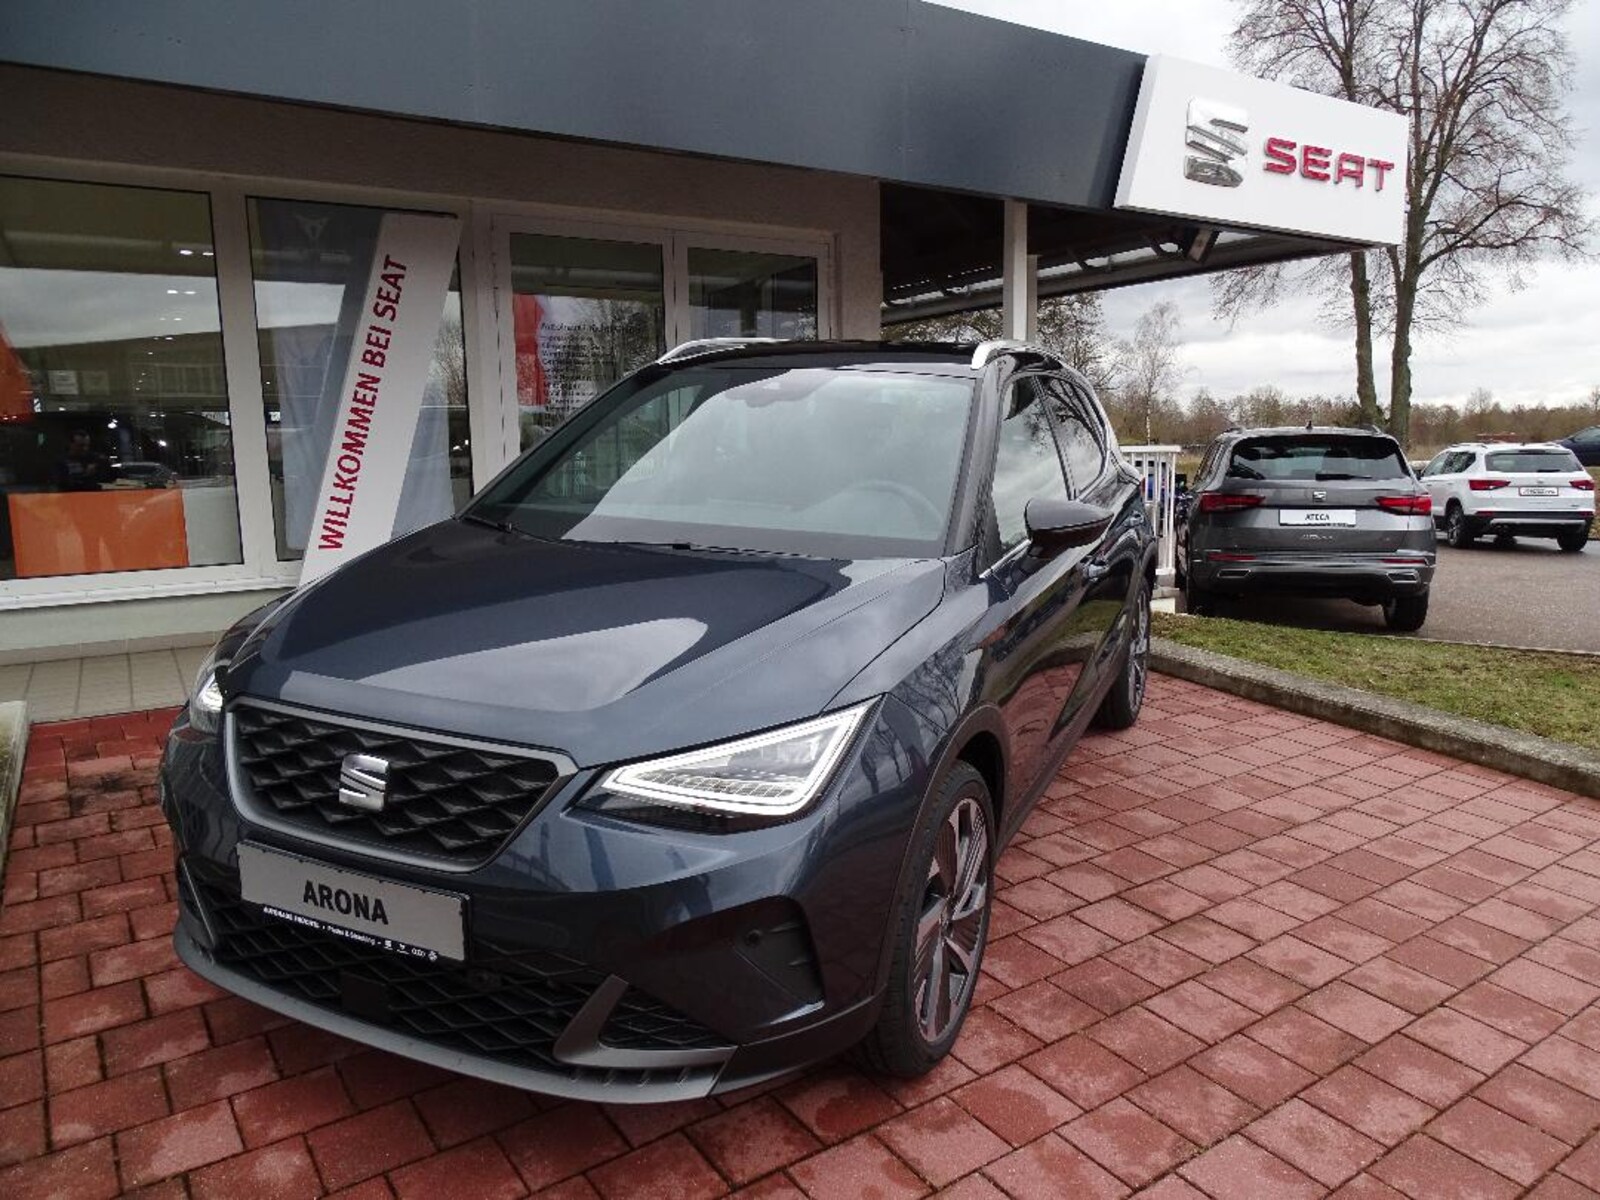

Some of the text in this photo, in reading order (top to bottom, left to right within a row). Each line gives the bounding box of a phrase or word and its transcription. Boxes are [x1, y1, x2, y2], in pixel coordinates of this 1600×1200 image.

[1263, 137, 1395, 191] SEAT
[318, 254, 407, 550] WILLKOMMEN BEI SEAT
[303, 880, 389, 925] ARONA
